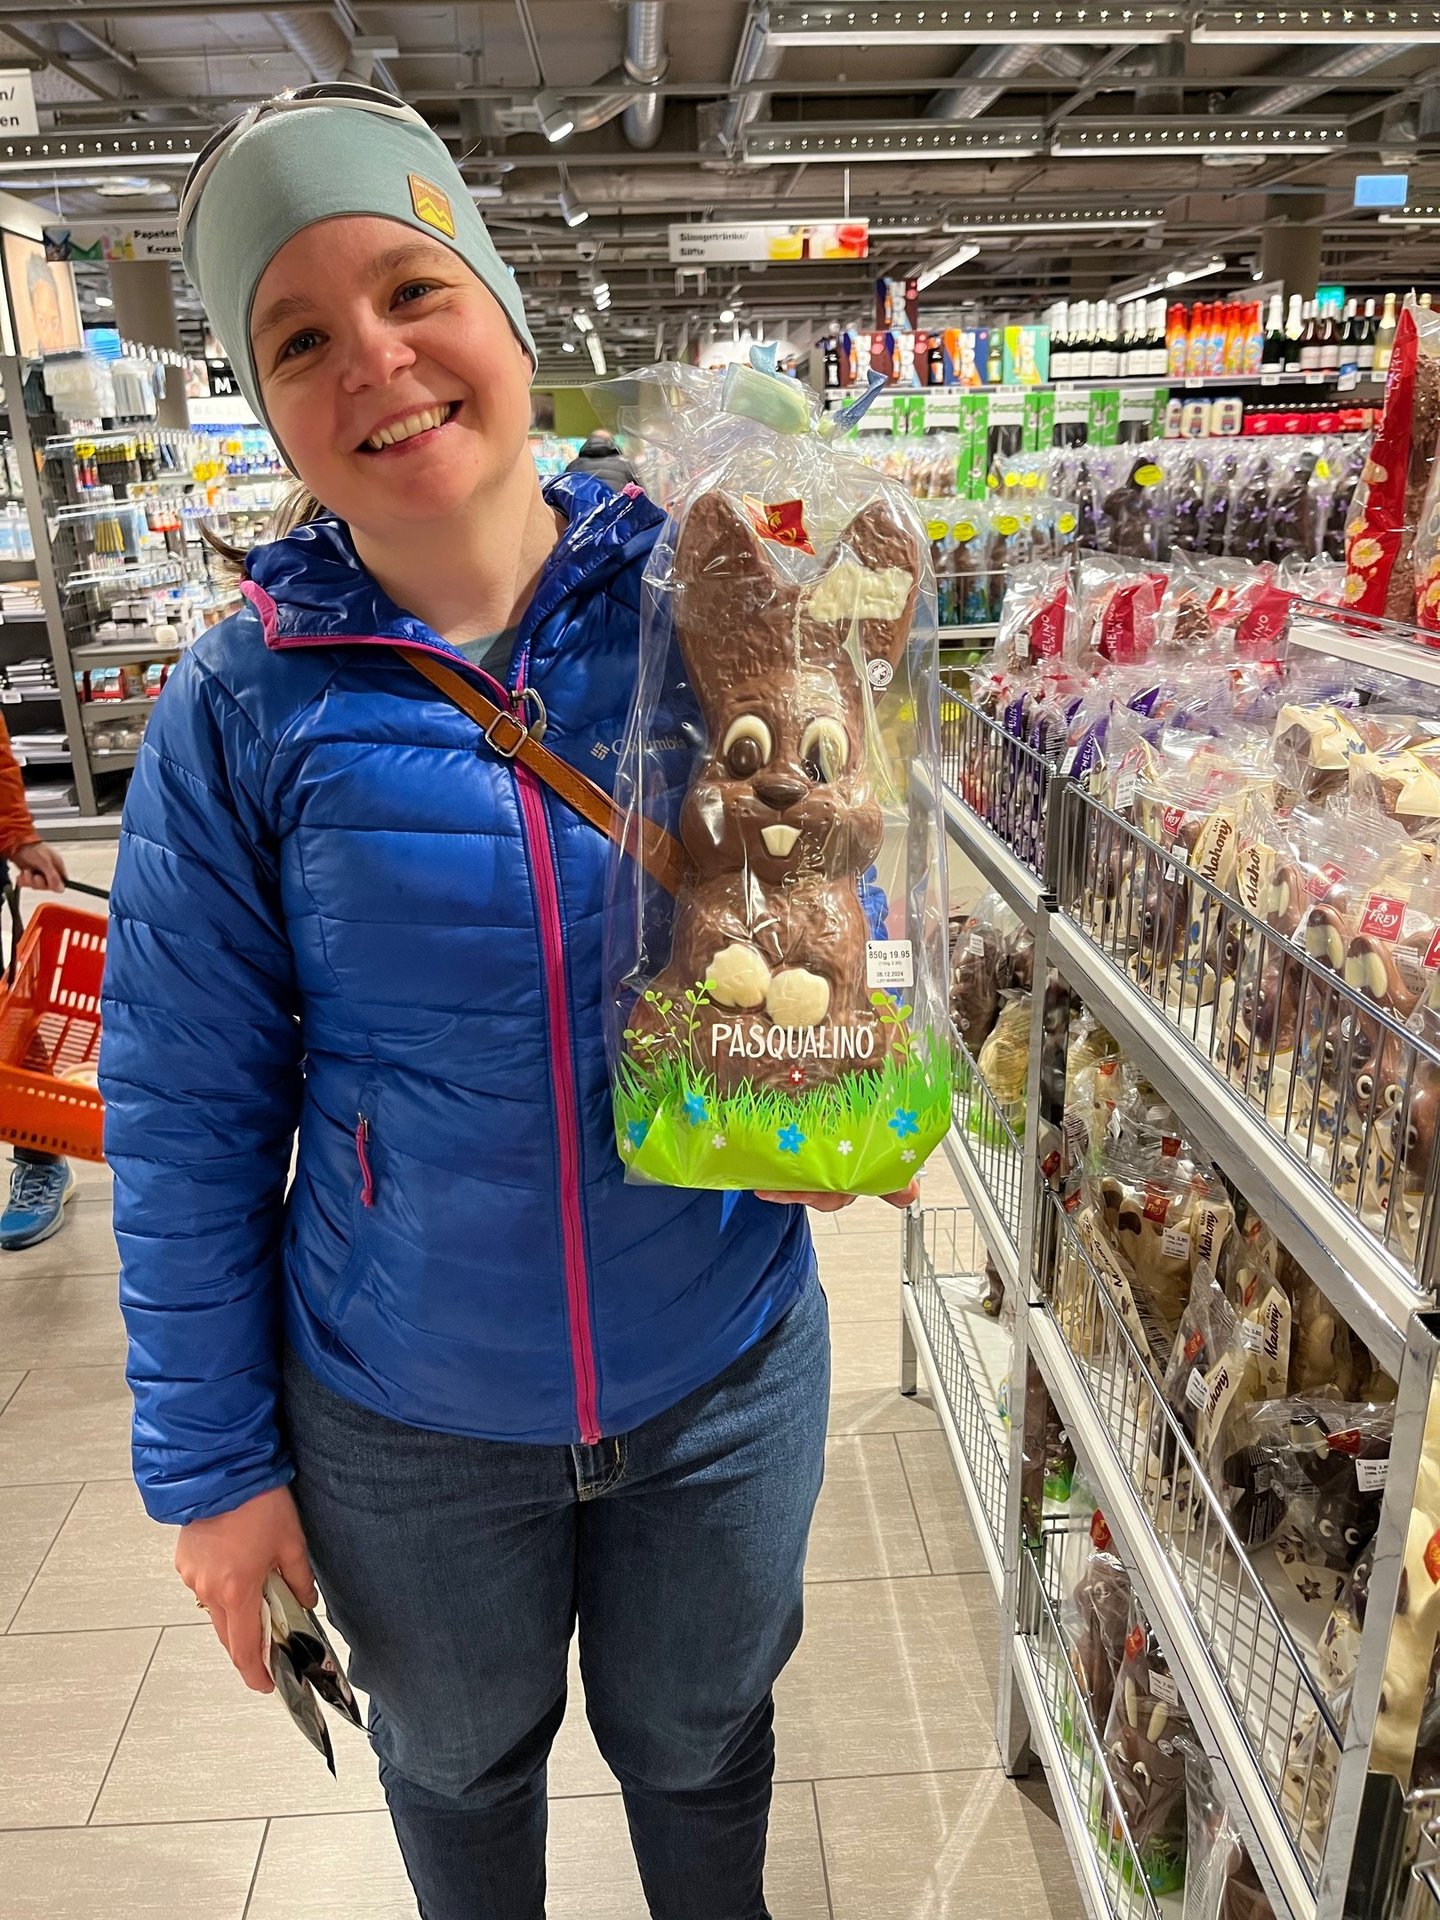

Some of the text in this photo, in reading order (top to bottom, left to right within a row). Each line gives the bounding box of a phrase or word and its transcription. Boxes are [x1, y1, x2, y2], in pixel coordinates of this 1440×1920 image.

[611, 735, 688, 756] Coumbia
[1200, 819, 1233, 883] Mahony
[1368, 908, 1399, 928] FREY
[869, 949, 911, 961] 850g 19.95
[711, 1023, 875, 1061] PASQUALINO
[1198, 1210, 1219, 1262] Mahony
[1263, 1303, 1284, 1362] Mahony
